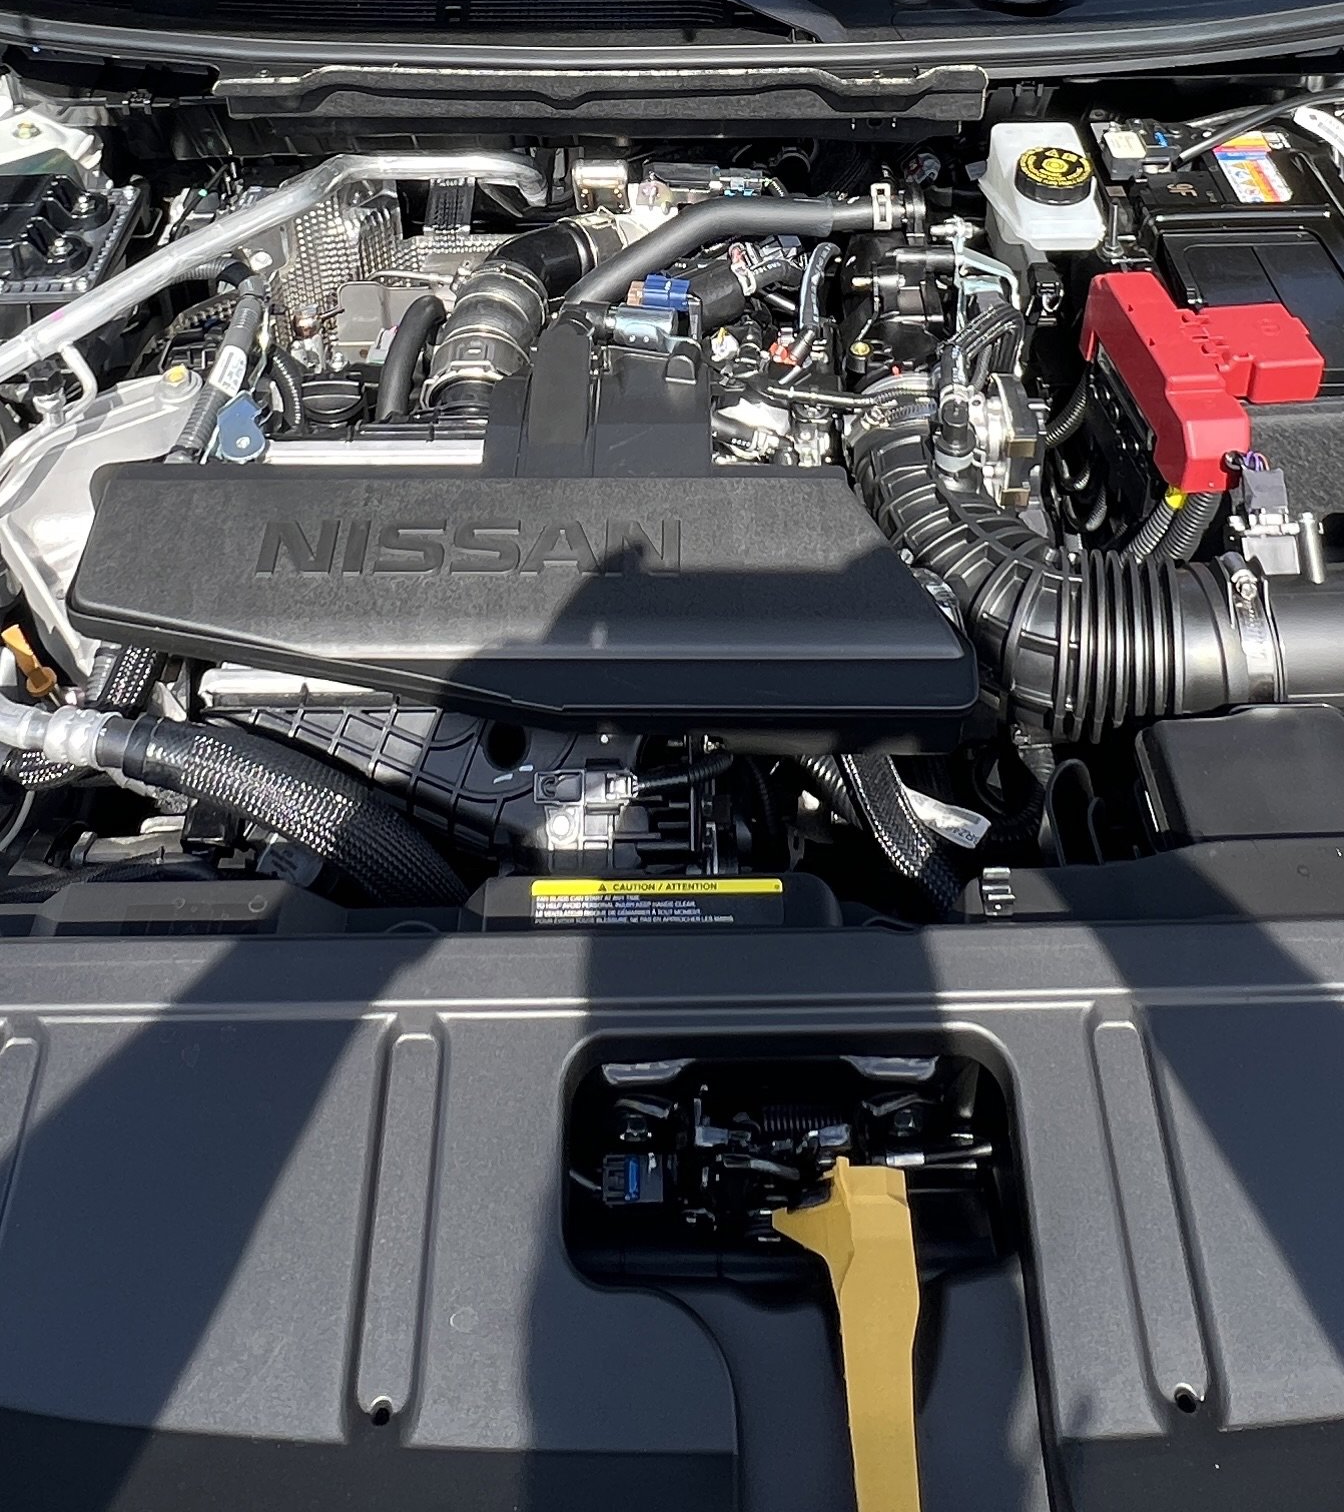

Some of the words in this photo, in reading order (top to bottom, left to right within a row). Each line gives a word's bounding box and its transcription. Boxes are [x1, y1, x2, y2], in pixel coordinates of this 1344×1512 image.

[255, 519, 682, 579] NISSAN
[613, 883, 656, 892] CAUTION
[665, 883, 718, 891] ATTENTION
